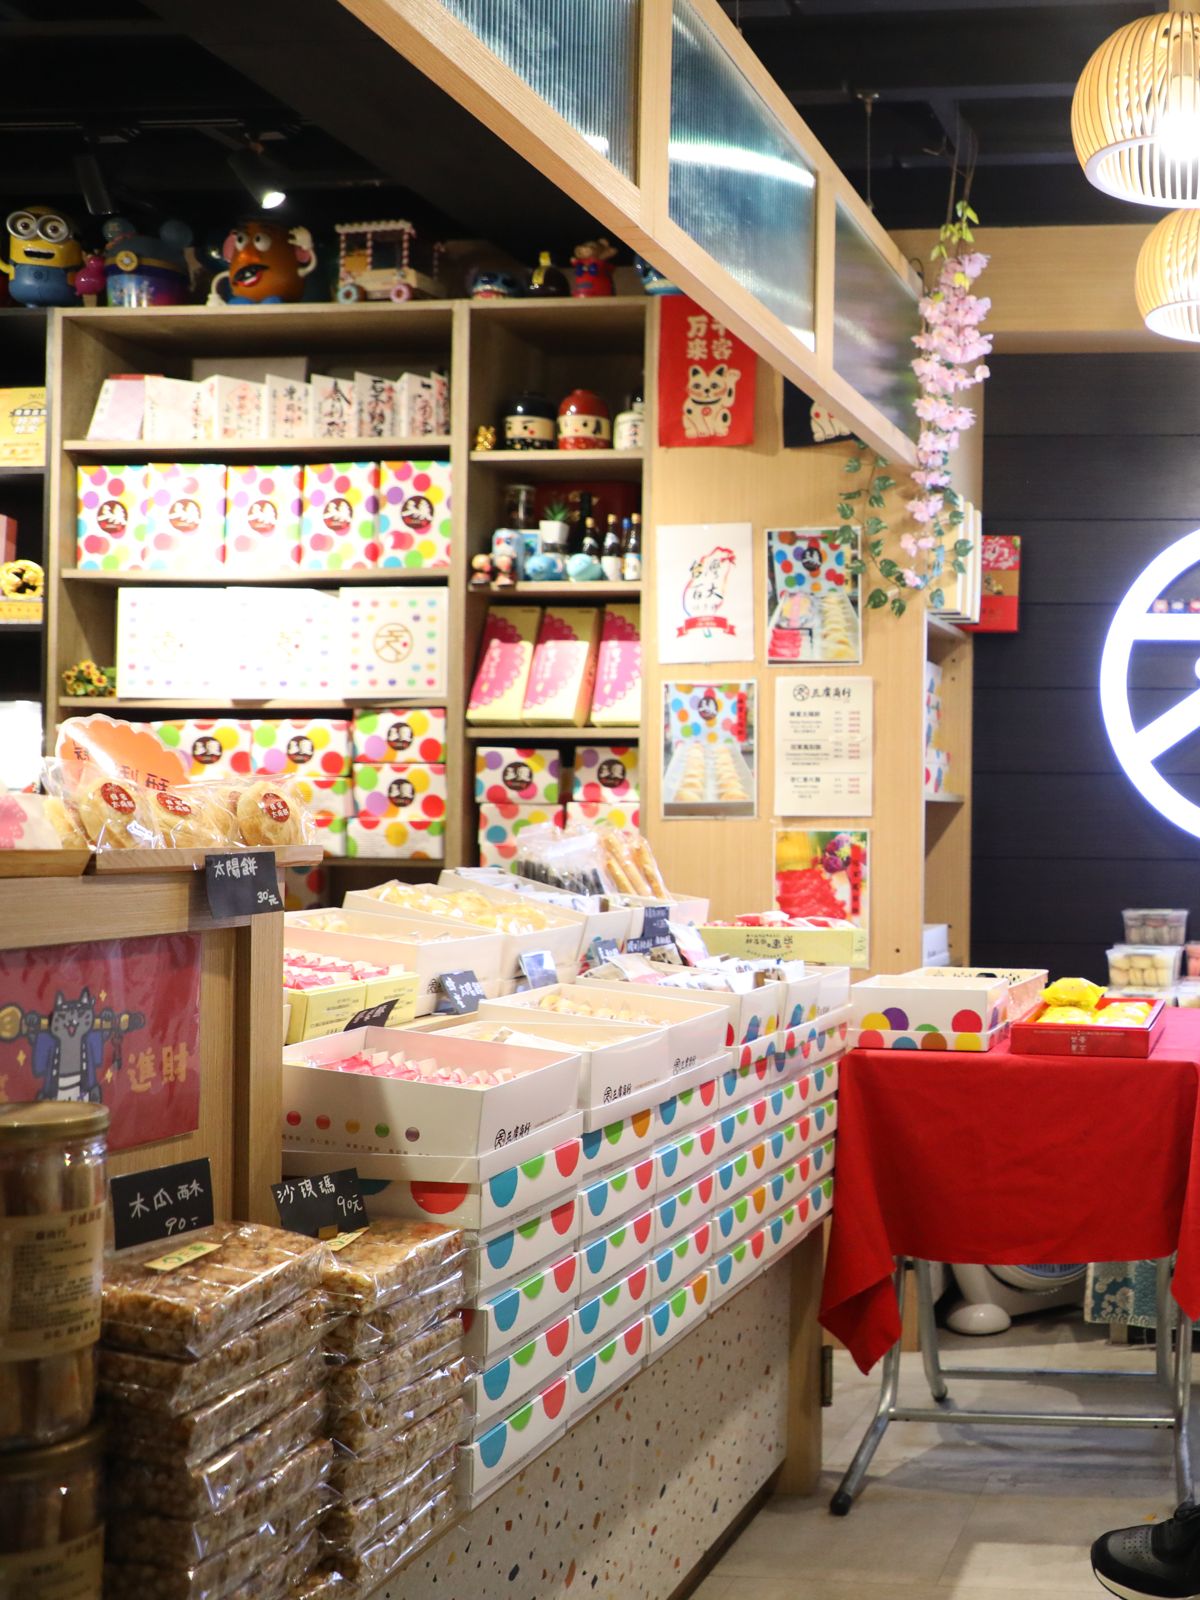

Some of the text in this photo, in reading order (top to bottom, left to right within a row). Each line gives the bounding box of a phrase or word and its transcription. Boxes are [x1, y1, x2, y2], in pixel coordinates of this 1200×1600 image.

[213, 857, 259, 880] 太陽餅
[127, 1042, 189, 1094] 進財
[128, 1180, 205, 1220] 木瓜酥
